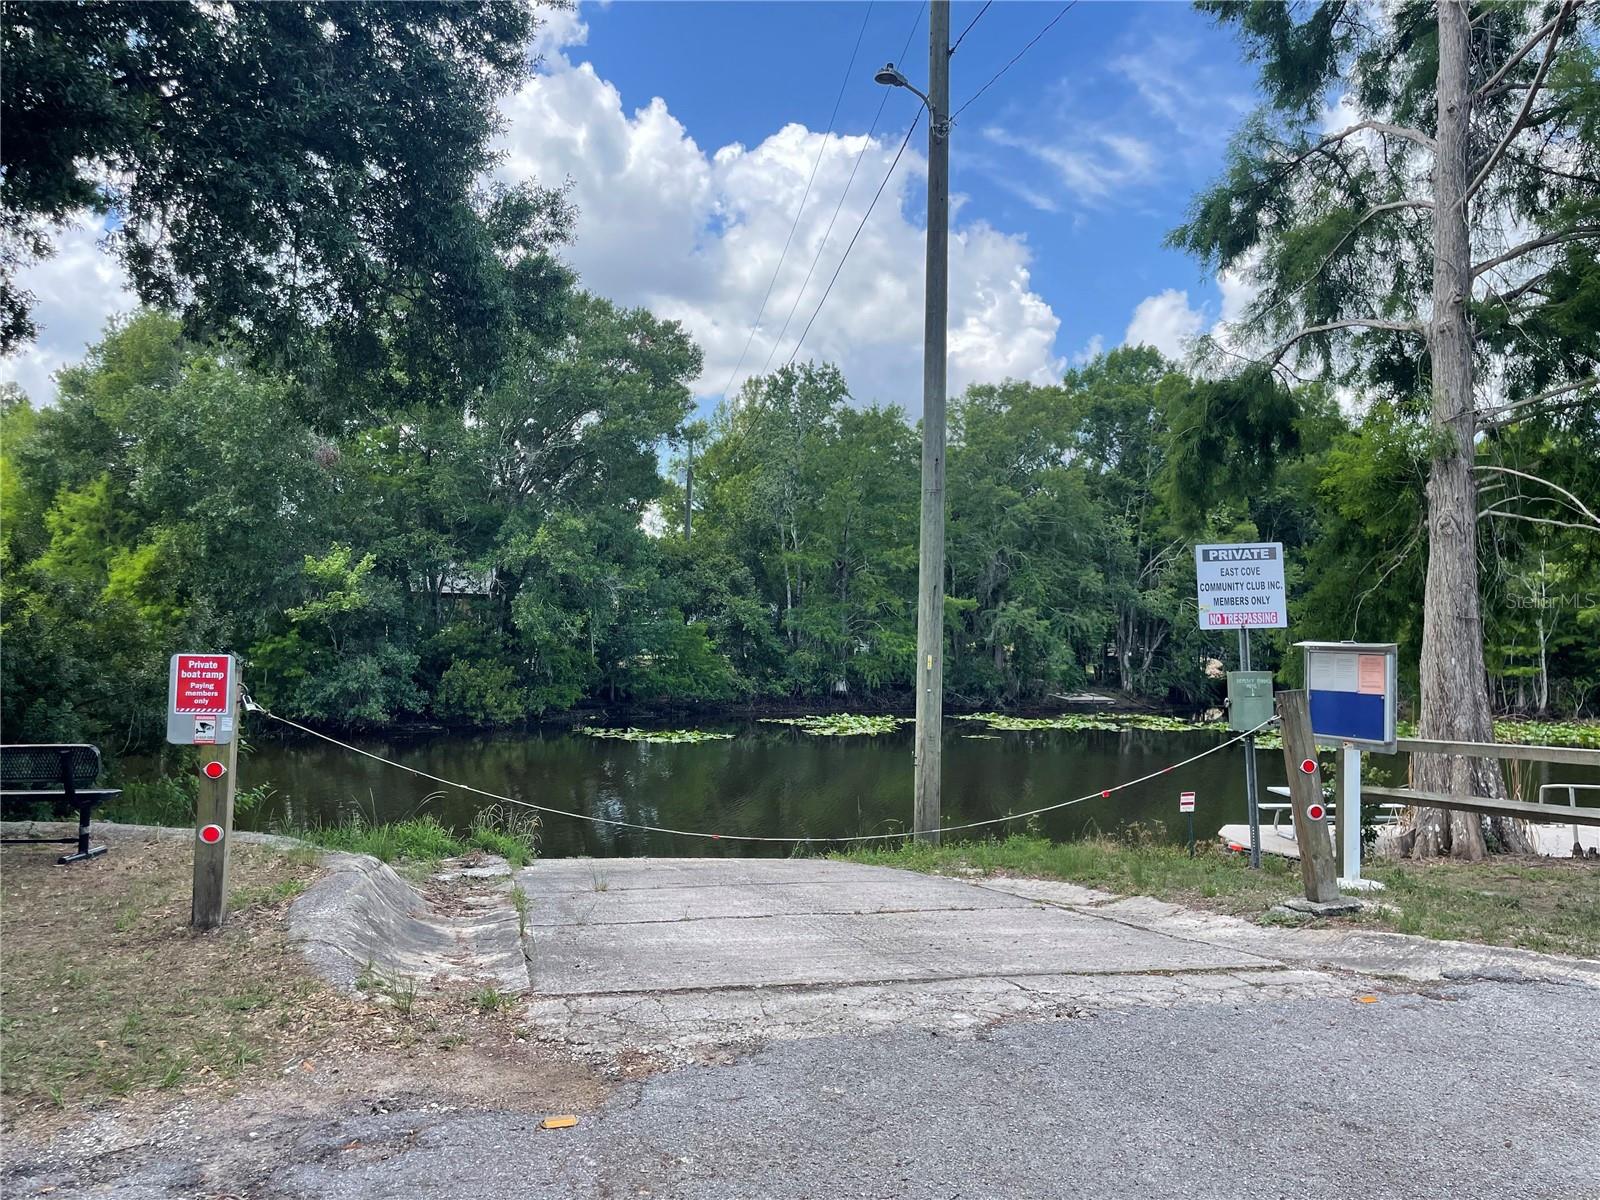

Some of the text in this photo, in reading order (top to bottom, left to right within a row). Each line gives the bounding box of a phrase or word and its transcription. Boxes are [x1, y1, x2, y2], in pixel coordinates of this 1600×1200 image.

[1209, 549, 1270, 560] PRIVATE
[1220, 567, 1261, 576] EAST COVE
[1200, 580, 1283, 592] COMMUNITY CLUB INC.
[1214, 596, 1270, 606] MEMBERS ONLY
[1210, 612, 1276, 624] NO TRESPASSING
[188, 660, 218, 669] Private
[181, 670, 224, 680] boat ramp
